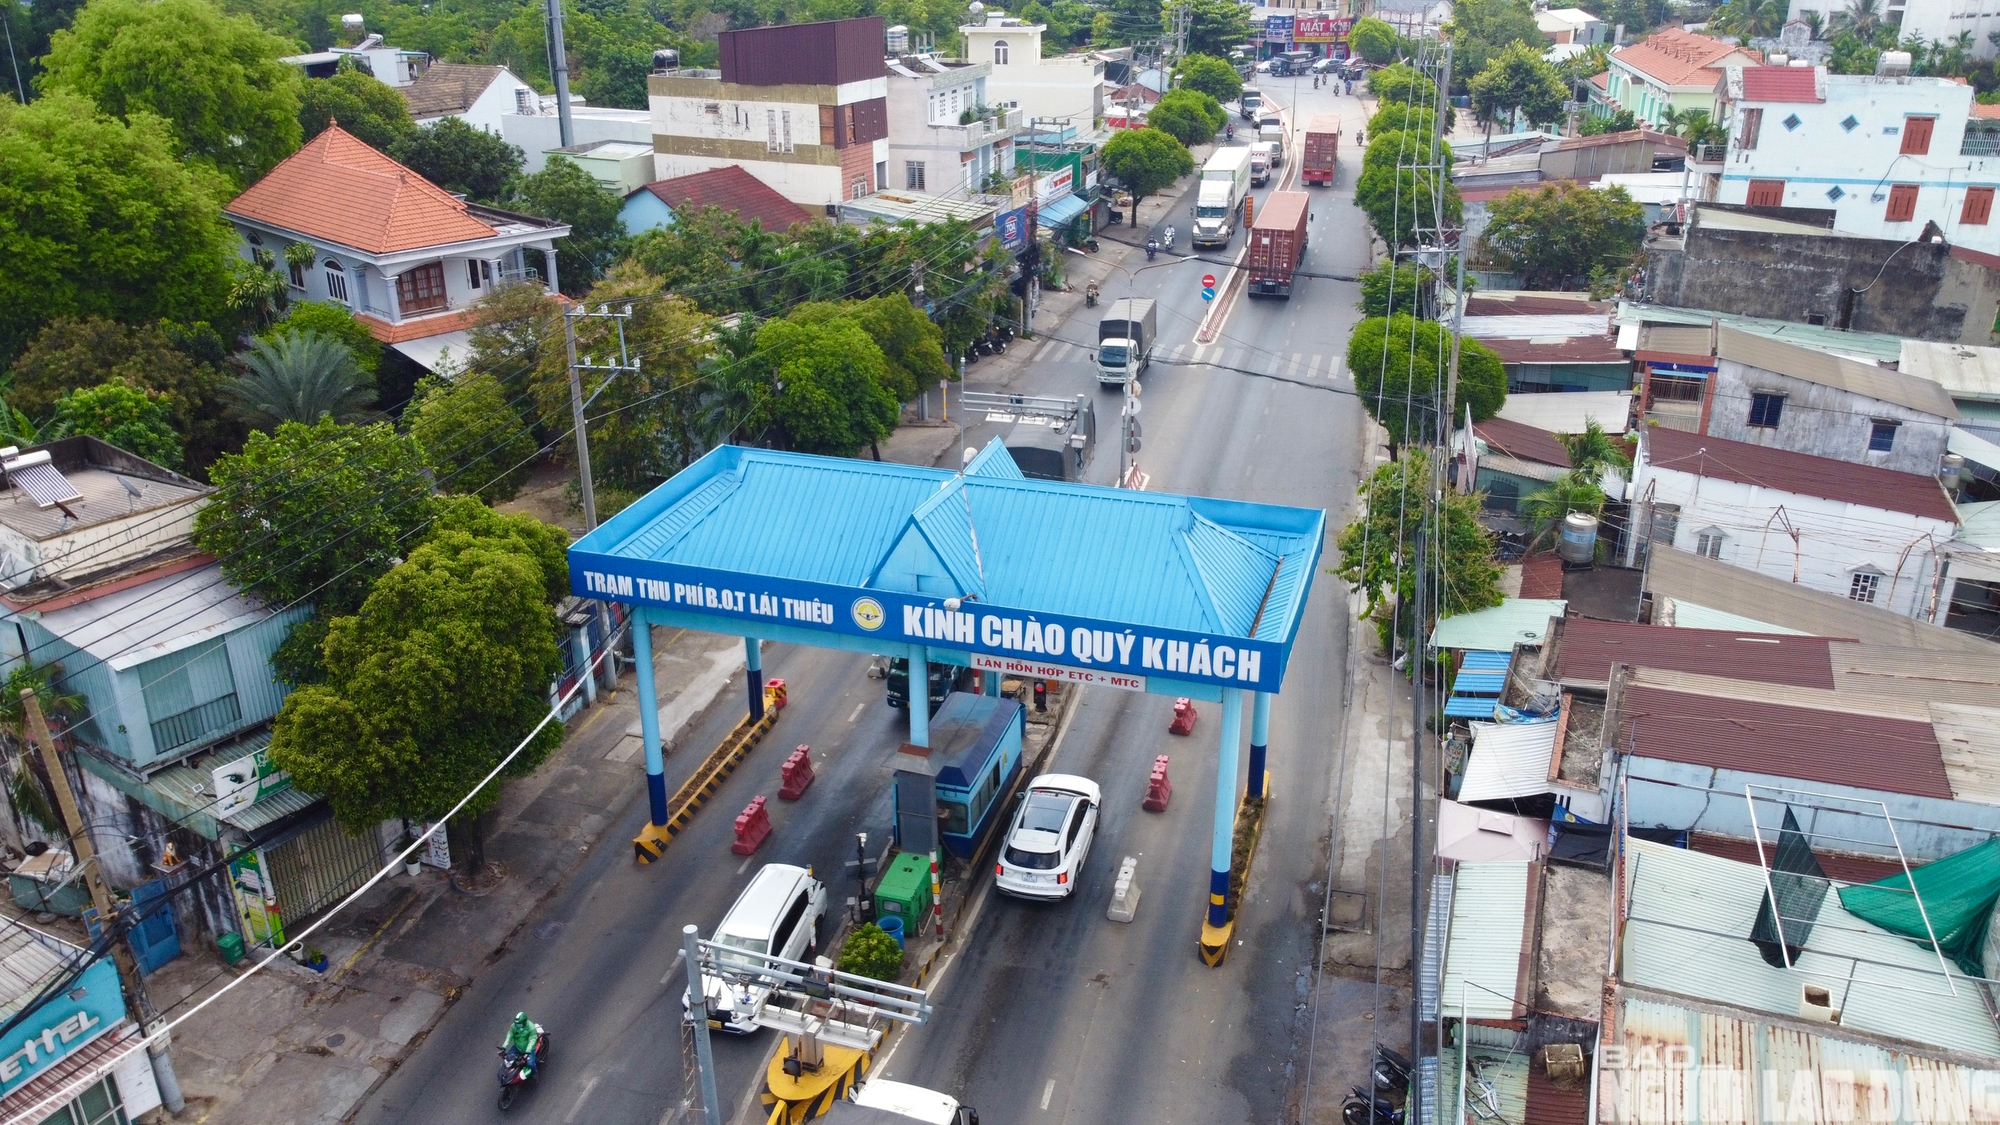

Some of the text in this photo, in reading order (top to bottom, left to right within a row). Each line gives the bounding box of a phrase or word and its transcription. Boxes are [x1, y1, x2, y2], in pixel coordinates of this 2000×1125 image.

[1300, 19, 1325, 31] MẮT
[583, 570, 634, 598] TRẠM
[636, 577, 671, 602] THU
[674, 582, 704, 606] PHÍ
[705, 587, 746, 612] B.O.T
[749, 591, 778, 617] LÁI
[781, 597, 834, 625] THIÊU
[903, 602, 1261, 683] KÍNH CHÀO QUÝ KHÁCH
[976, 656, 1002, 669] LÀN
[1006, 660, 1033, 674] HỖN
[1037, 667, 1065, 679] HỢP
[1068, 671, 1094, 682] ETC
[1110, 677, 1139, 688] MTC
